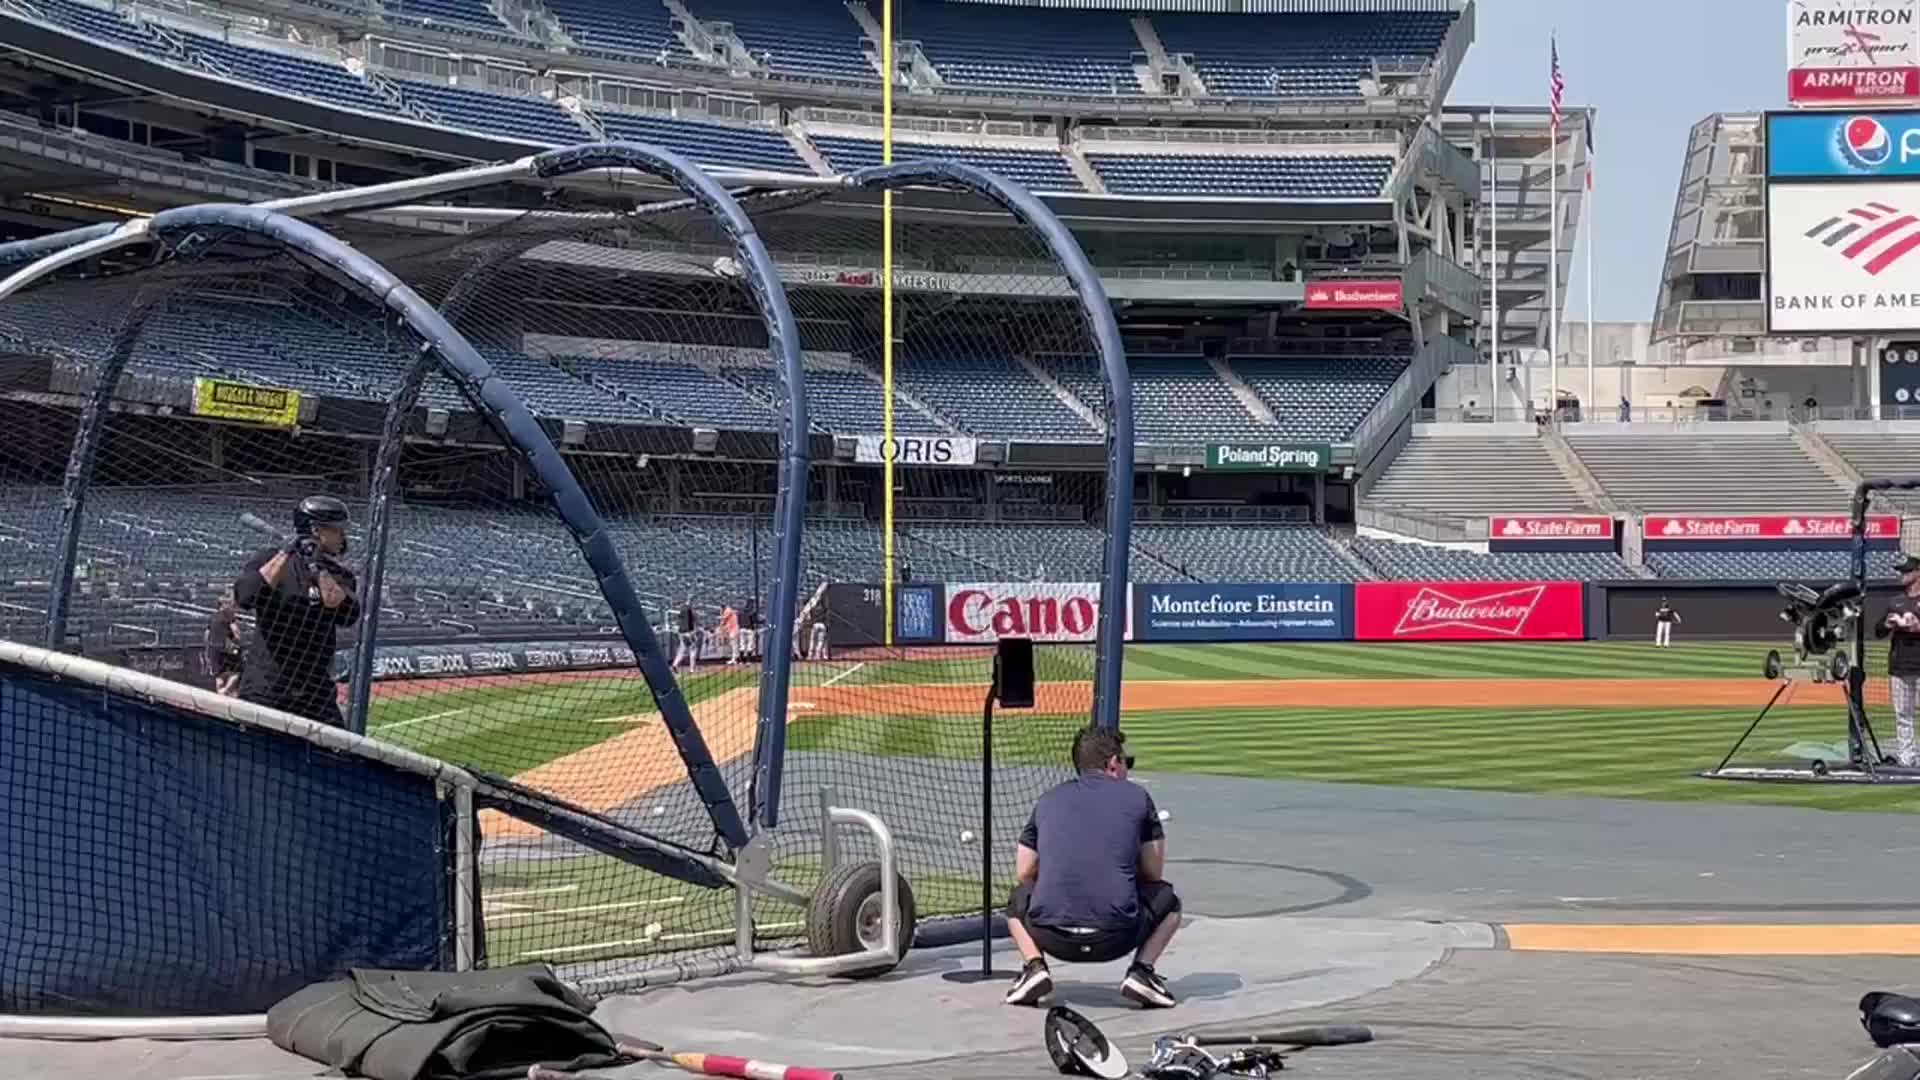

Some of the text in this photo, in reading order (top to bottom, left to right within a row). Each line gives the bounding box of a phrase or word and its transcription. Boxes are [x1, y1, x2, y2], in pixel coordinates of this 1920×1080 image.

[1797, 9, 1913, 26] ARMITRON
[1803, 70, 1907, 87] ARMITRON
[836, 271, 873, 285] Audi
[1335, 290, 1397, 302] Budweiser
[1775, 295, 1833, 310] BANK
[1841, 294, 1868, 309] OF
[879, 439, 952, 462] ORIS
[1218, 446, 1319, 467] Poland Spring
[1151, 594, 1334, 613] Montefiore Einstein
[1408, 599, 1529, 621] Budweiser
